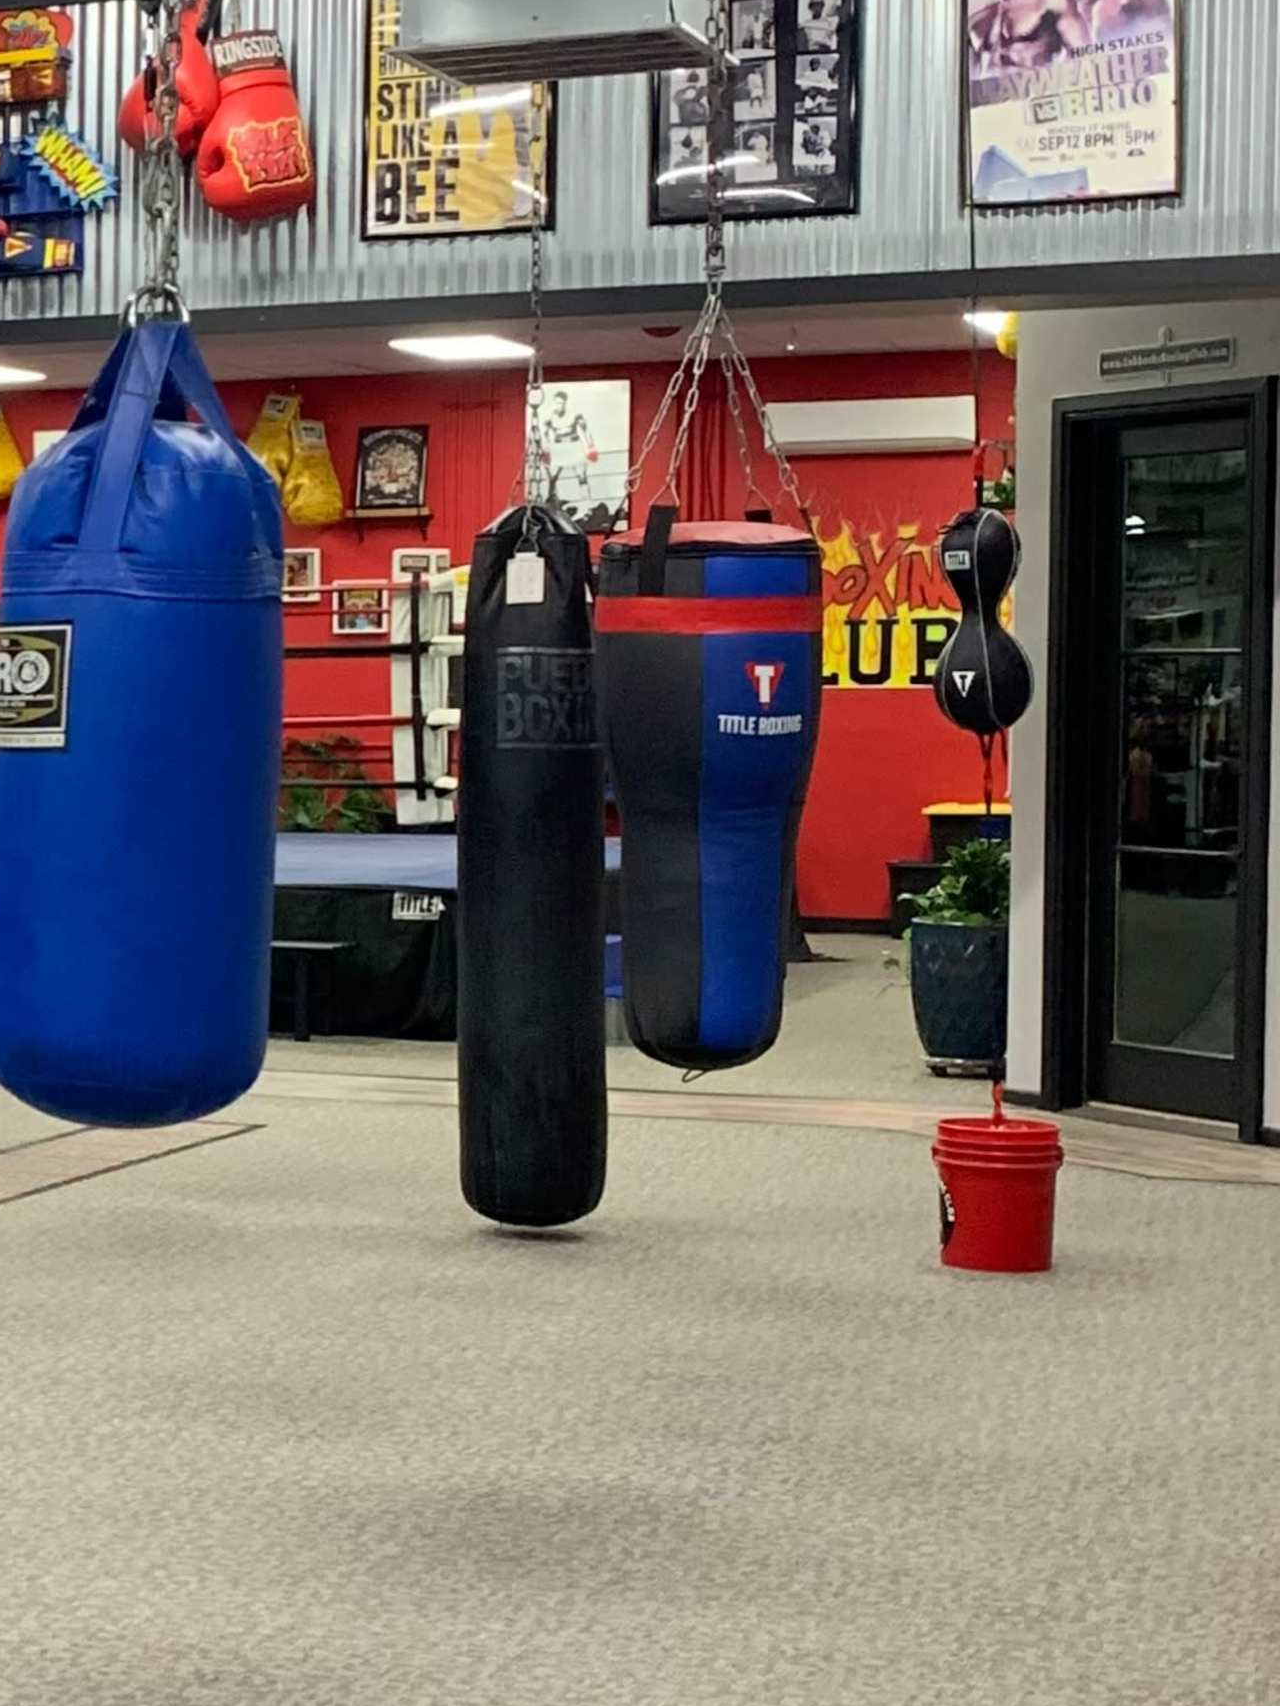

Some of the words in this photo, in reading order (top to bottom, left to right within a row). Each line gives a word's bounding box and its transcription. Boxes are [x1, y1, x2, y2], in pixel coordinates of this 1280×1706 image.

[1070, 43, 1105, 59] HIGH
[1109, 31, 1164, 53] STAKES
[1061, 80, 1157, 120] BERTO
[376, 120, 432, 161] LIKE
[443, 120, 459, 158] A
[1038, 133, 1063, 152] SEP
[1065, 132, 1080, 150] 12
[1083, 130, 1114, 147] 8PM
[1125, 128, 1156, 145] 5PM
[34, 125, 107, 199] WHAM!
[374, 159, 460, 225] BEE
[823, 536, 963, 620] OXIN
[822, 618, 960, 685] UB
[497, 654, 592, 693] PUEB
[717, 713, 757, 735] TITLE
[757, 714, 803, 735] BOXING
[399, 895, 434, 913] TITLE
